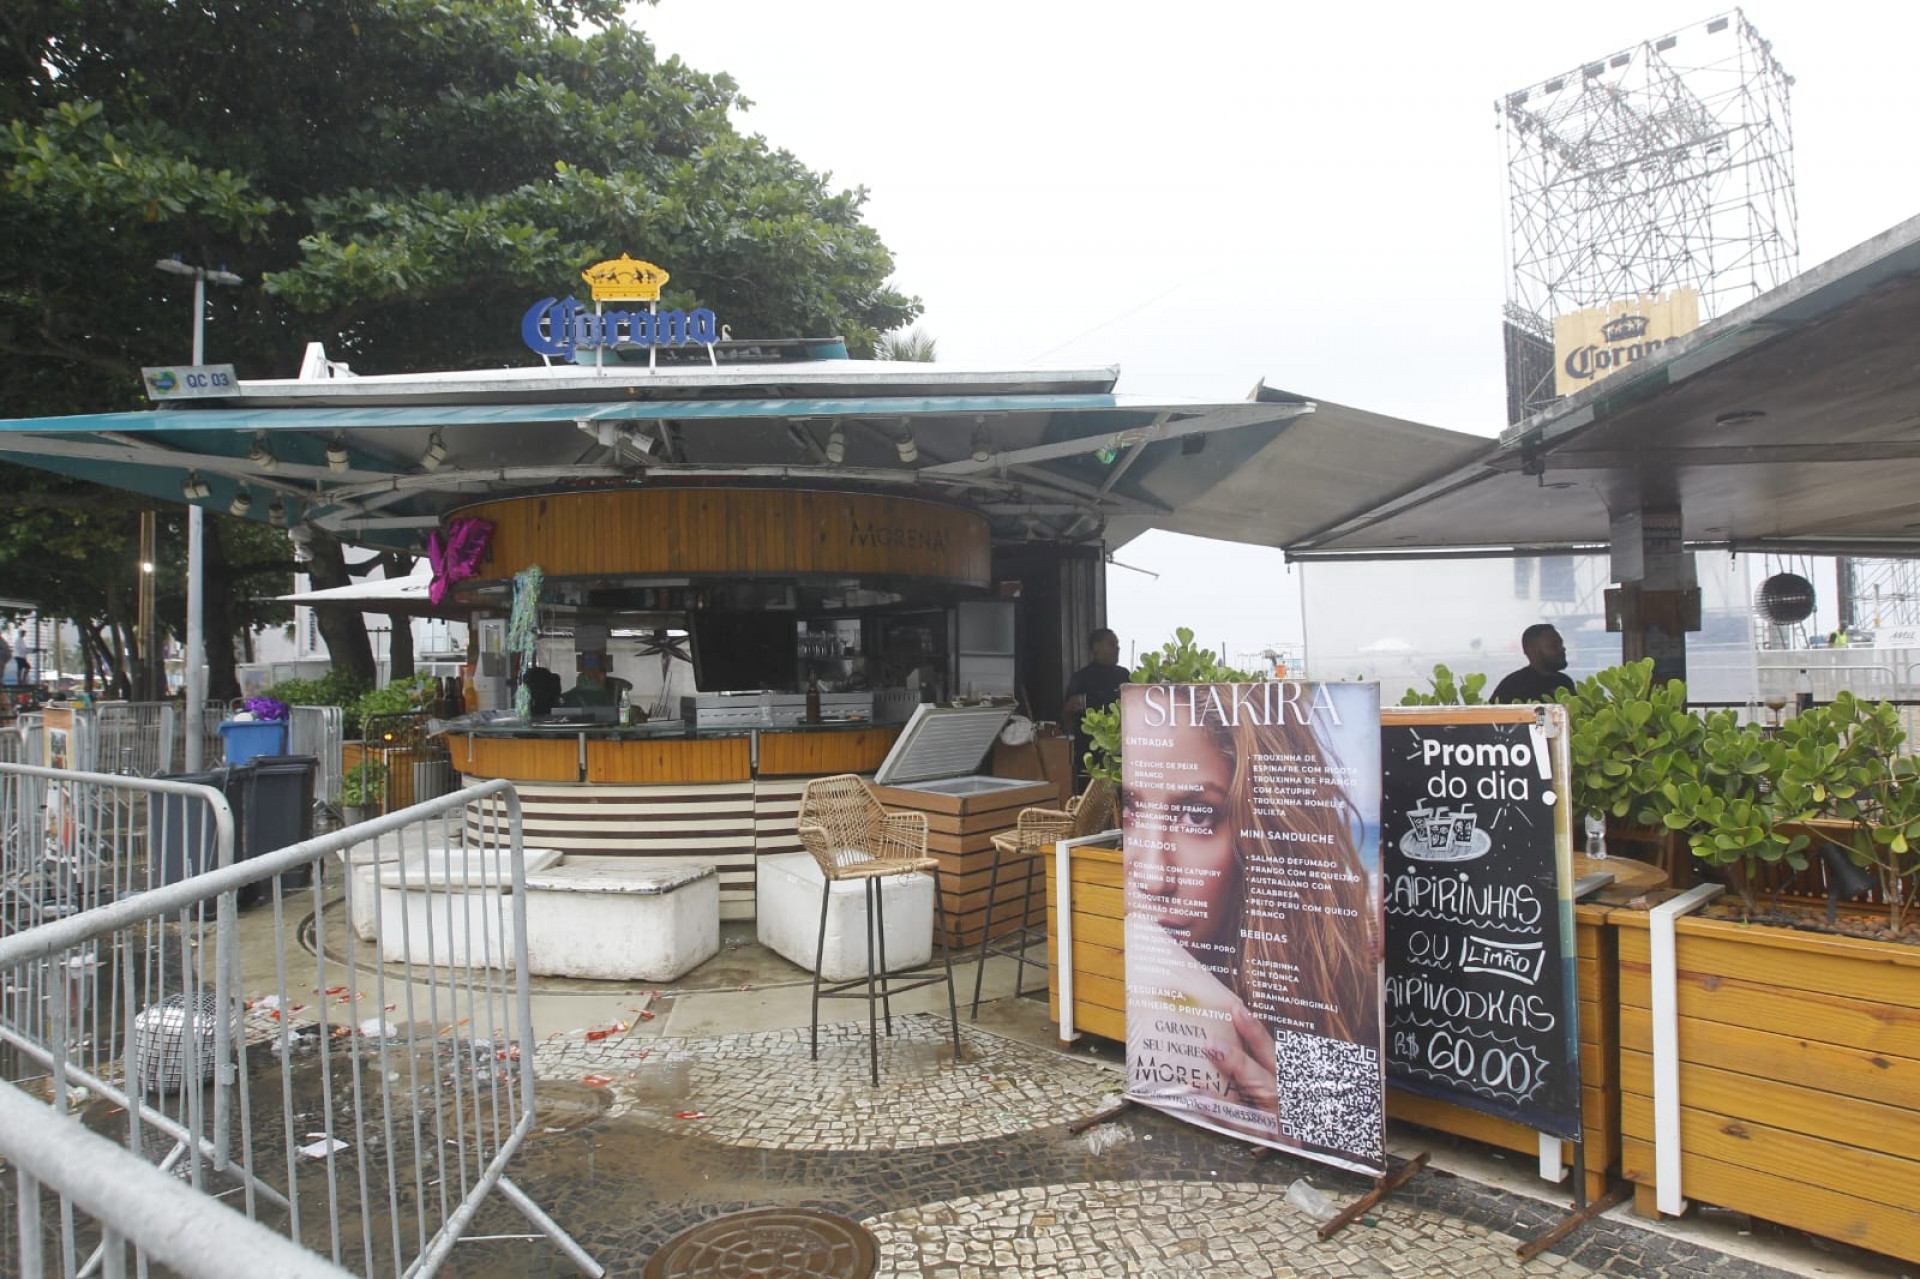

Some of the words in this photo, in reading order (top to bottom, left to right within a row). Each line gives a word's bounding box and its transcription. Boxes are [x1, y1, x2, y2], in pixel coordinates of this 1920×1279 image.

[521, 295, 720, 363] Corona
[186, 374, 208, 388] QC
[211, 373, 229, 386] 03
[1144, 682, 1343, 727] SHAKIRA
[1126, 737, 1174, 748] ENTRADAS
[1253, 754, 1301, 762] TROUXINHA
[1134, 760, 1164, 769] CEVICHE
[1253, 765, 1300, 773] ESPINAFRE
[1301, 766, 1321, 774] COM
[1324, 767, 1359, 775] RICOTA
[1253, 775, 1302, 784] TROUXINHA
[1305, 777, 1318, 785] DE
[1320, 778, 1357, 786] FRANGO
[1427, 770, 1467, 799] do
[1477, 770, 1529, 800] dia
[1134, 781, 1164, 790] CEVICHE
[1177, 784, 1205, 792] MANGA
[1253, 786, 1272, 794] COM
[1274, 787, 1316, 796] CATUPIRY
[1171, 804, 1181, 812] DE
[1253, 797, 1302, 806] TROUXINHA
[1305, 799, 1337, 808] ROMEU
[1253, 808, 1286, 817] JULIETA
[1169, 825, 1179, 833] DE
[1181, 826, 1214, 835] TAPIOCA
[1240, 829, 1264, 839] MINI
[1267, 831, 1335, 844] SANDUICHE
[1287, 857, 1337, 868] DEFUMADO
[1166, 865, 1183, 873] COM
[1251, 865, 1284, 875] FRANGO
[1287, 868, 1306, 876] COM
[1251, 876, 1309, 888] AUSTRALIANO
[1312, 882, 1332, 890] COM
[1251, 887, 1300, 898] CALABRESA
[1169, 907, 1208, 919] CROCANTE
[1251, 898, 1275, 908] PEITO
[1278, 901, 1299, 910] PERU
[1302, 904, 1321, 912] COM
[1325, 906, 1358, 917] QUEIJO
[1251, 909, 1285, 919] BRANCO
[1240, 929, 1288, 943] BEBIDAS
[1191, 941, 1211, 950] ALHO
[1409, 931, 1449, 960] OU
[1252, 959, 1299, 972] CAIPIRINHA
[1252, 980, 1288, 992] CERVEJA
[1179, 1005, 1232, 1021] PRIVATIVO
[1253, 1013, 1315, 1030] REFRIGERANTE
[1155, 1020, 1207, 1039] GARANTA
[1143, 1038, 1163, 1052] SEU
[1168, 1041, 1225, 1062] INGRESSO
[1135, 1055, 1243, 1097] MORENA
